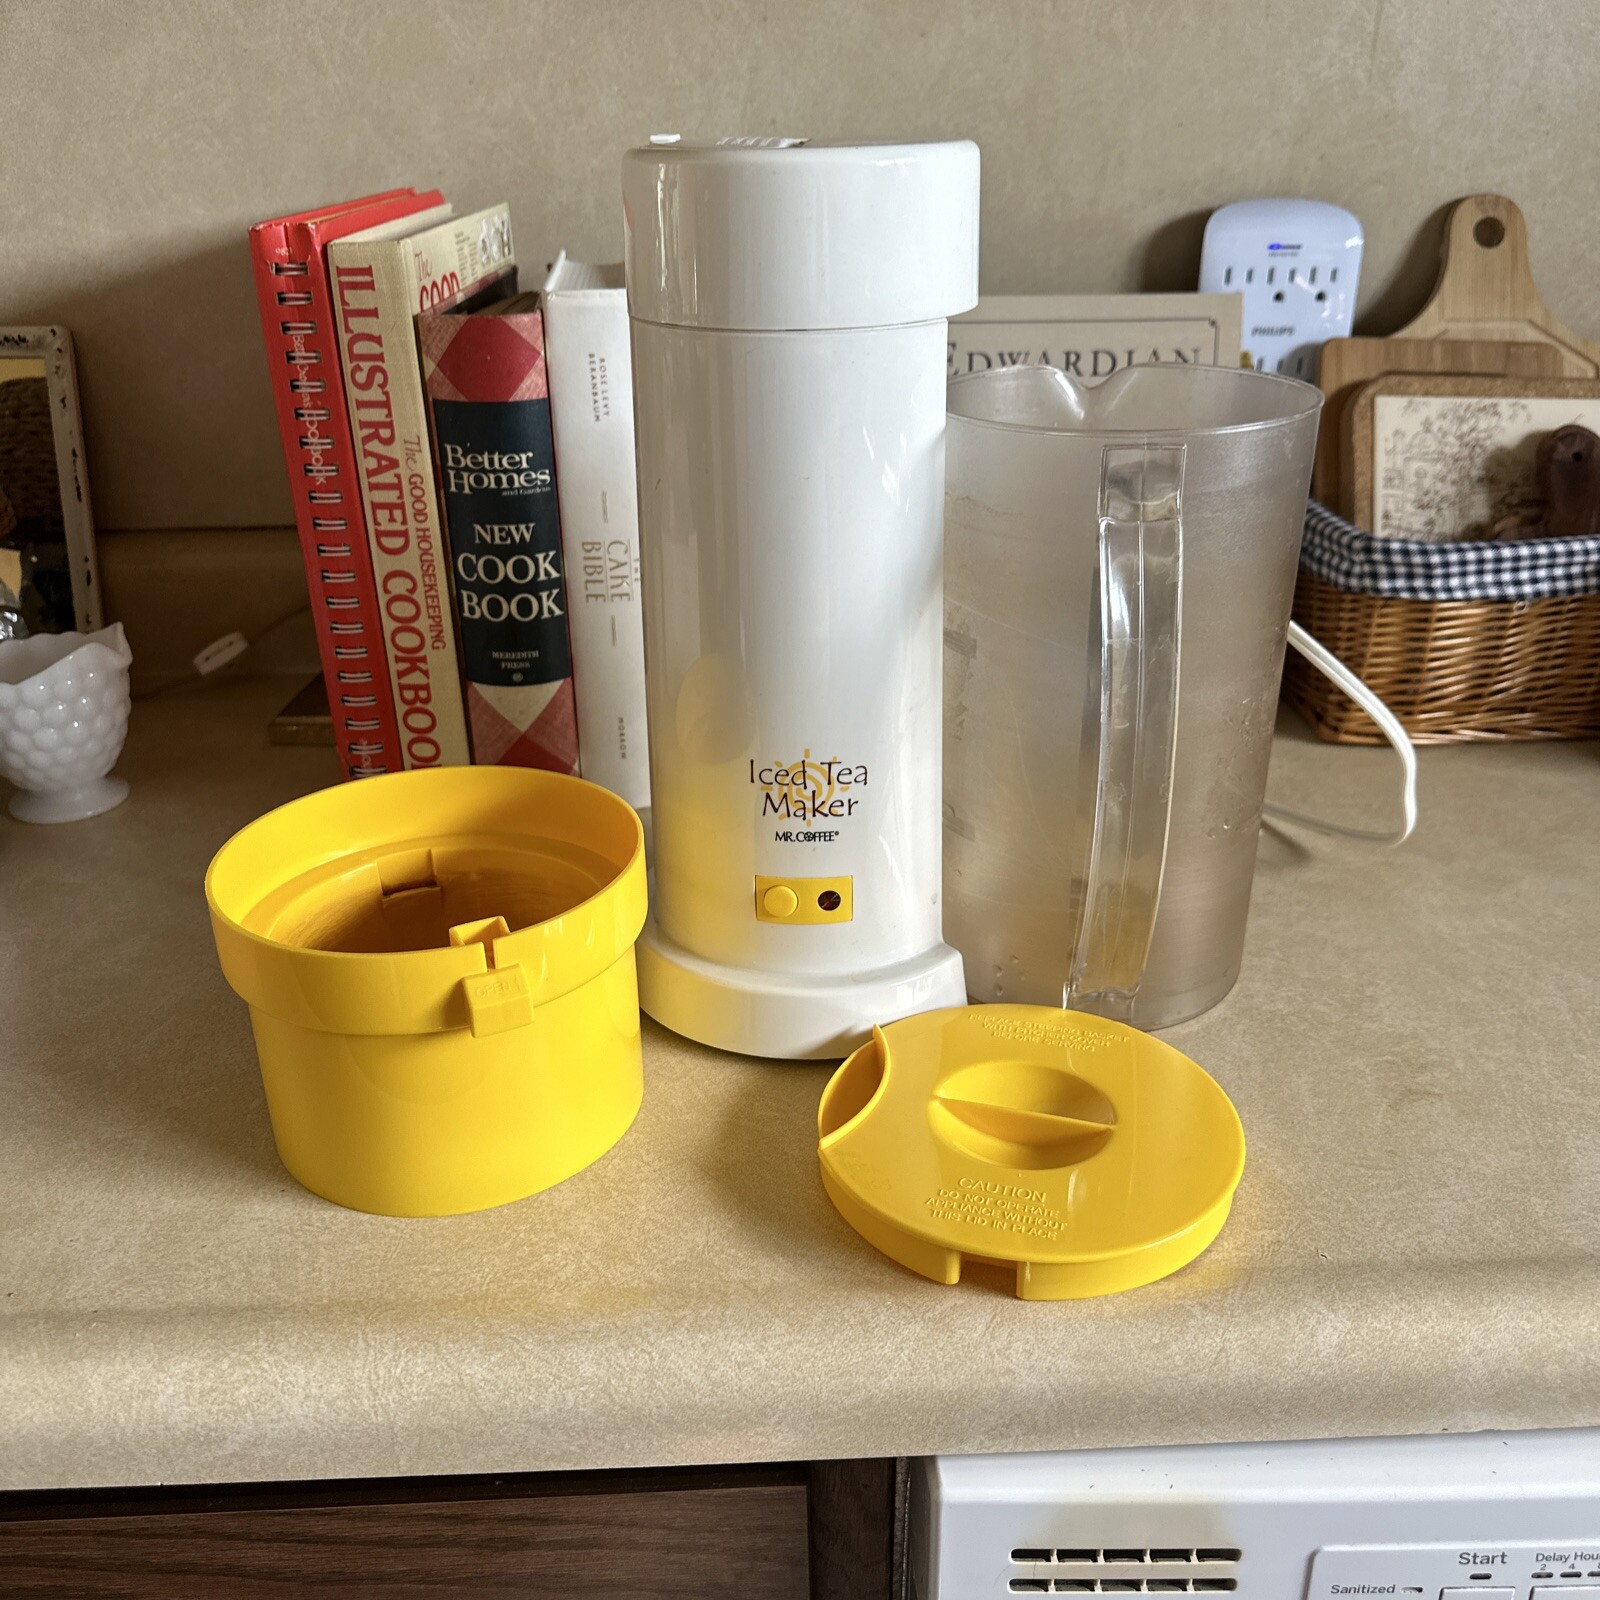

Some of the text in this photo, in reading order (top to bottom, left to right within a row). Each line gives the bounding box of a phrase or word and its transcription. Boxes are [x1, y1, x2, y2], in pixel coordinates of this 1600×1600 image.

[588, 353, 601, 422] BERANBAUM
[601, 389, 611, 417] LEVY
[444, 443, 534, 470] Better
[447, 468, 551, 495] Homes
[408, 473, 429, 524] GOOD
[335, 264, 442, 770] ILLUSTRATED COOKBOO
[472, 522, 536, 546] NEW
[457, 550, 561, 584] COOK
[581, 540, 606, 604] BIBLE
[606, 539, 631, 603] CAKE
[415, 527, 447, 651] HOUSEKEEPING
[460, 588, 565, 622] BOOK
[491, 649, 540, 660] MEREDITH
[501, 661, 531, 670] PRESS
[617, 716, 627, 760] MORROW
[750, 758, 869, 790] Iced Tea
[762, 789, 859, 821] Maker
[938, 1188, 1061, 1219] DO NOT OPERATE
[957, 1176, 1047, 1204] CAUTION
[925, 1197, 1069, 1231] APPLIANCE WITHOUT
[931, 1208, 1059, 1241] THIS LID IN PLACE
[1458, 1551, 1508, 1566] Start
[1535, 1552, 1571, 1564] Delay
[1540, 1562, 1576, 1571] 2 4
[1330, 1583, 1396, 1595] Sanitized
